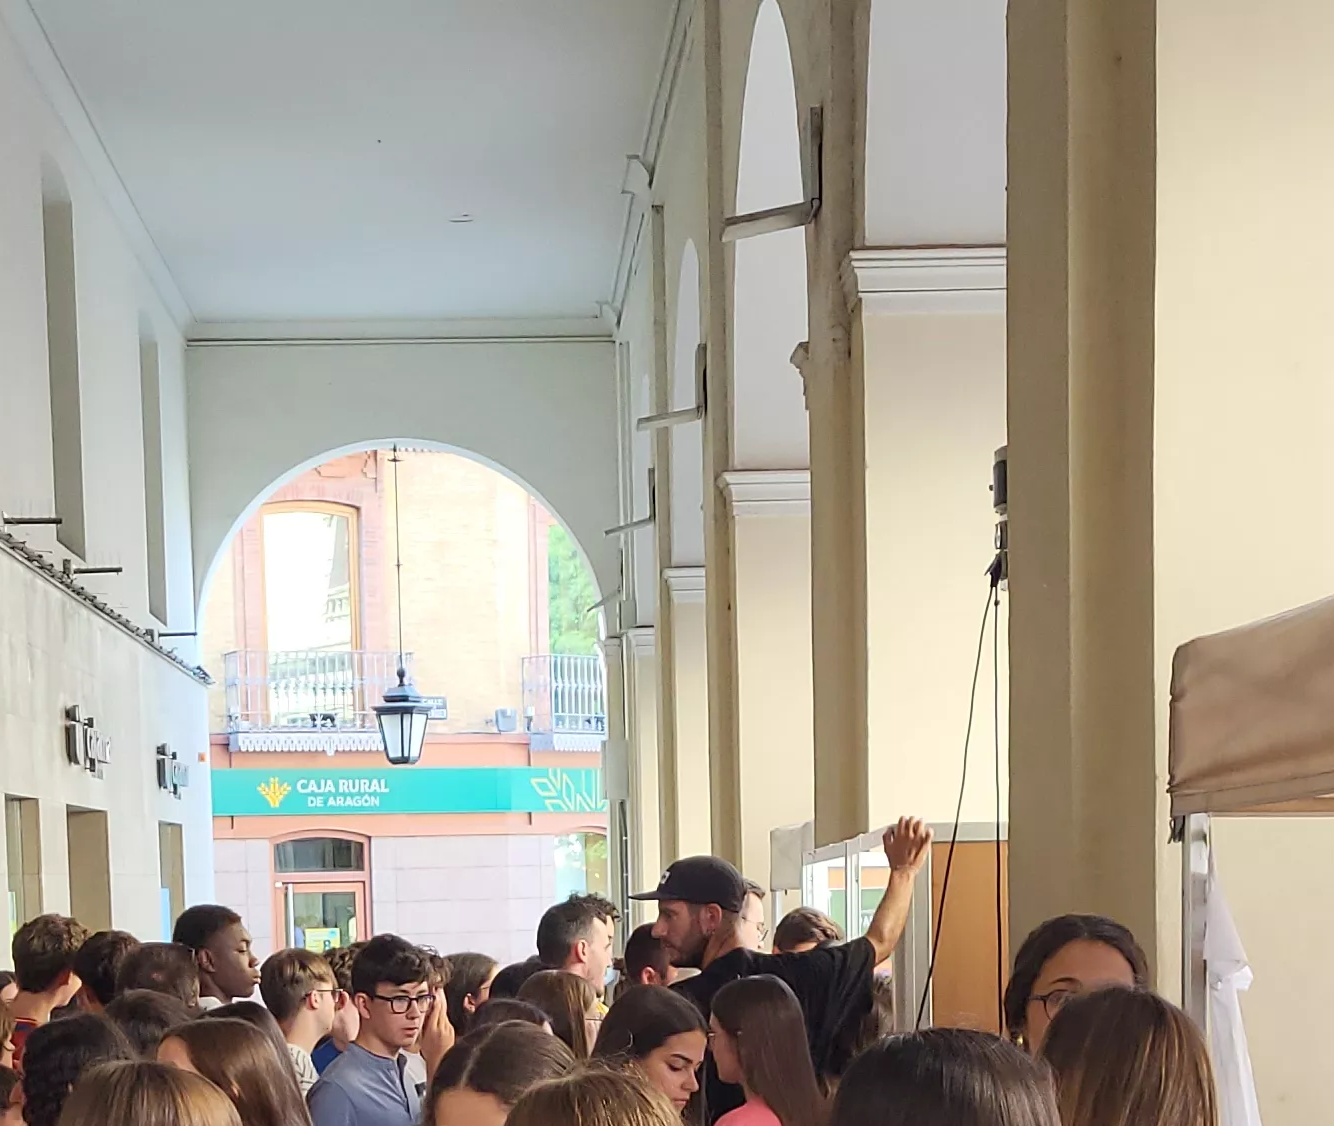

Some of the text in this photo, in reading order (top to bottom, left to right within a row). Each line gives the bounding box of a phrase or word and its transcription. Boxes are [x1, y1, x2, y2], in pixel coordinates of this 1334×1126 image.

[296, 779, 389, 793] CAJA RURAL
[307, 793, 380, 807] DE ARAGÓN
